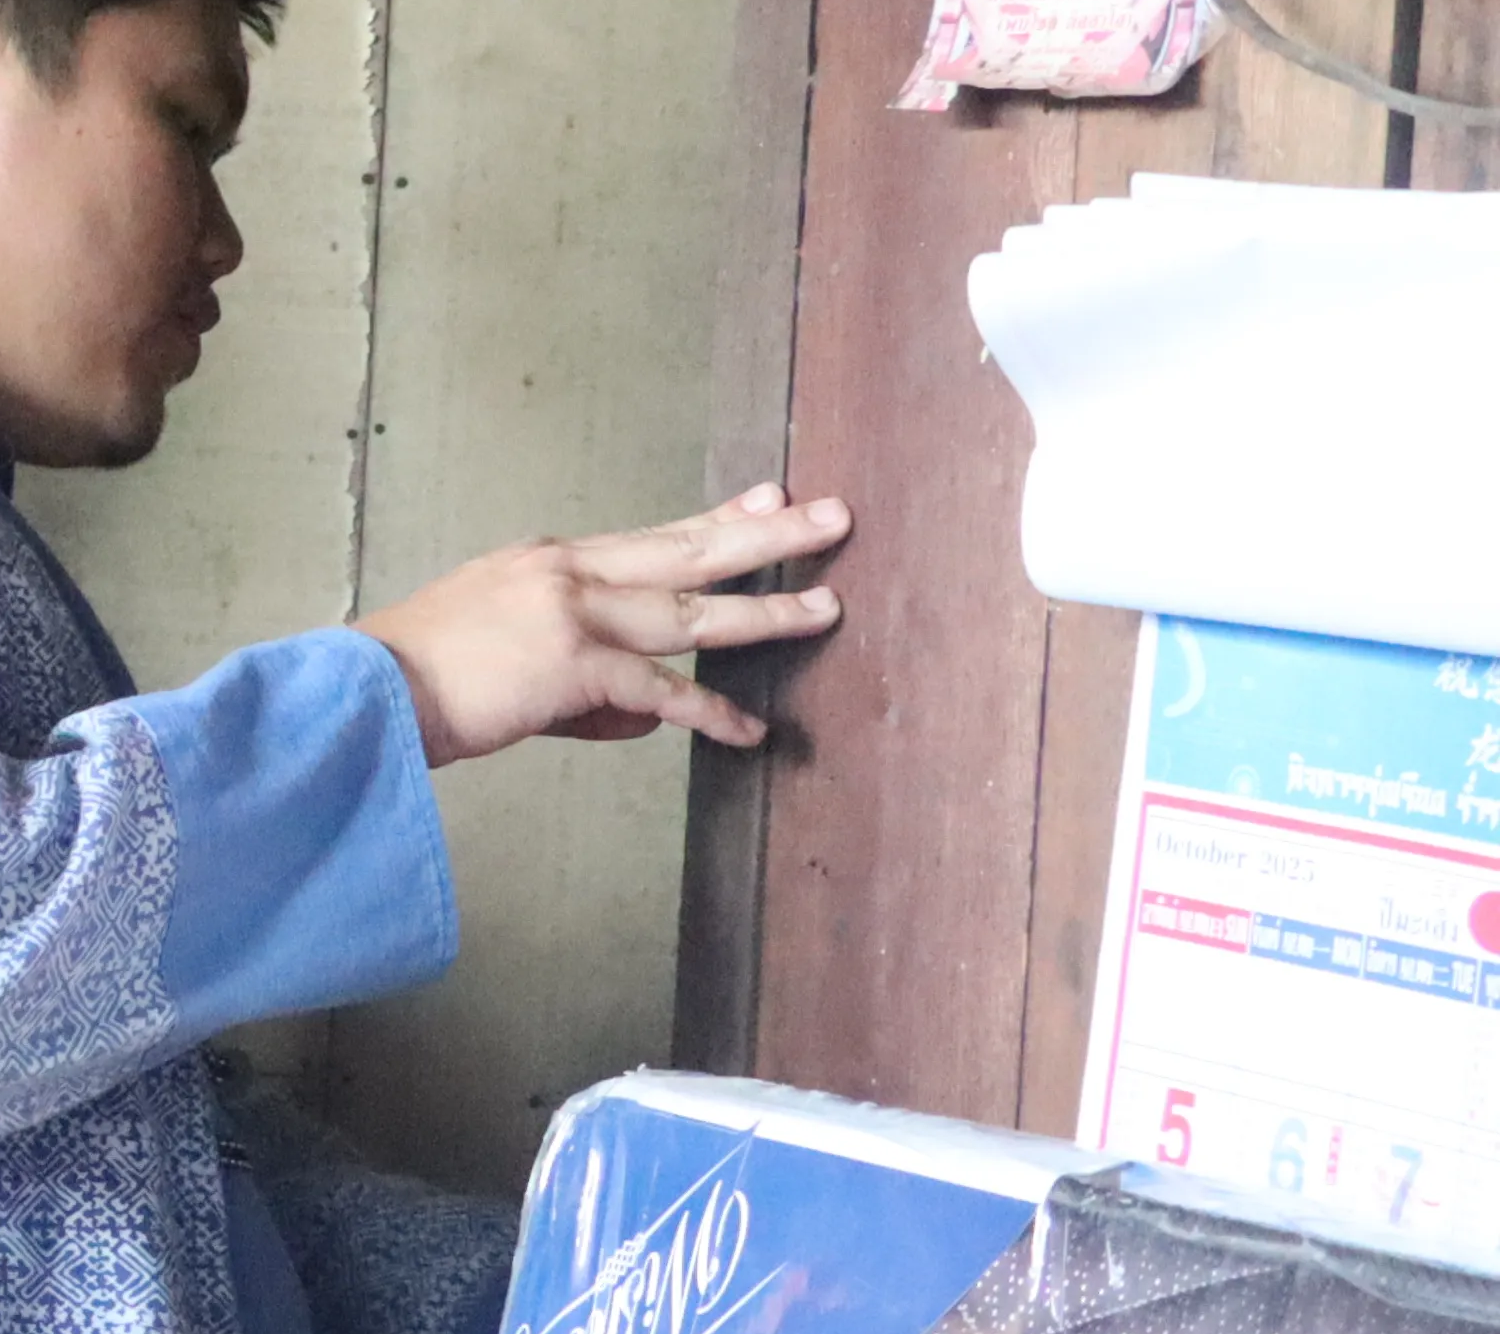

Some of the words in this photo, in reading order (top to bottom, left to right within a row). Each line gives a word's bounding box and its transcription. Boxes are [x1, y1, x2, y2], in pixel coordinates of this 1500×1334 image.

[1156, 831, 1249, 869] October
[1258, 849, 1315, 884] 2025
[1157, 1087, 1196, 1167] 5
[1268, 1117, 1308, 1194] 6
[1389, 1144, 1423, 1226] 7
